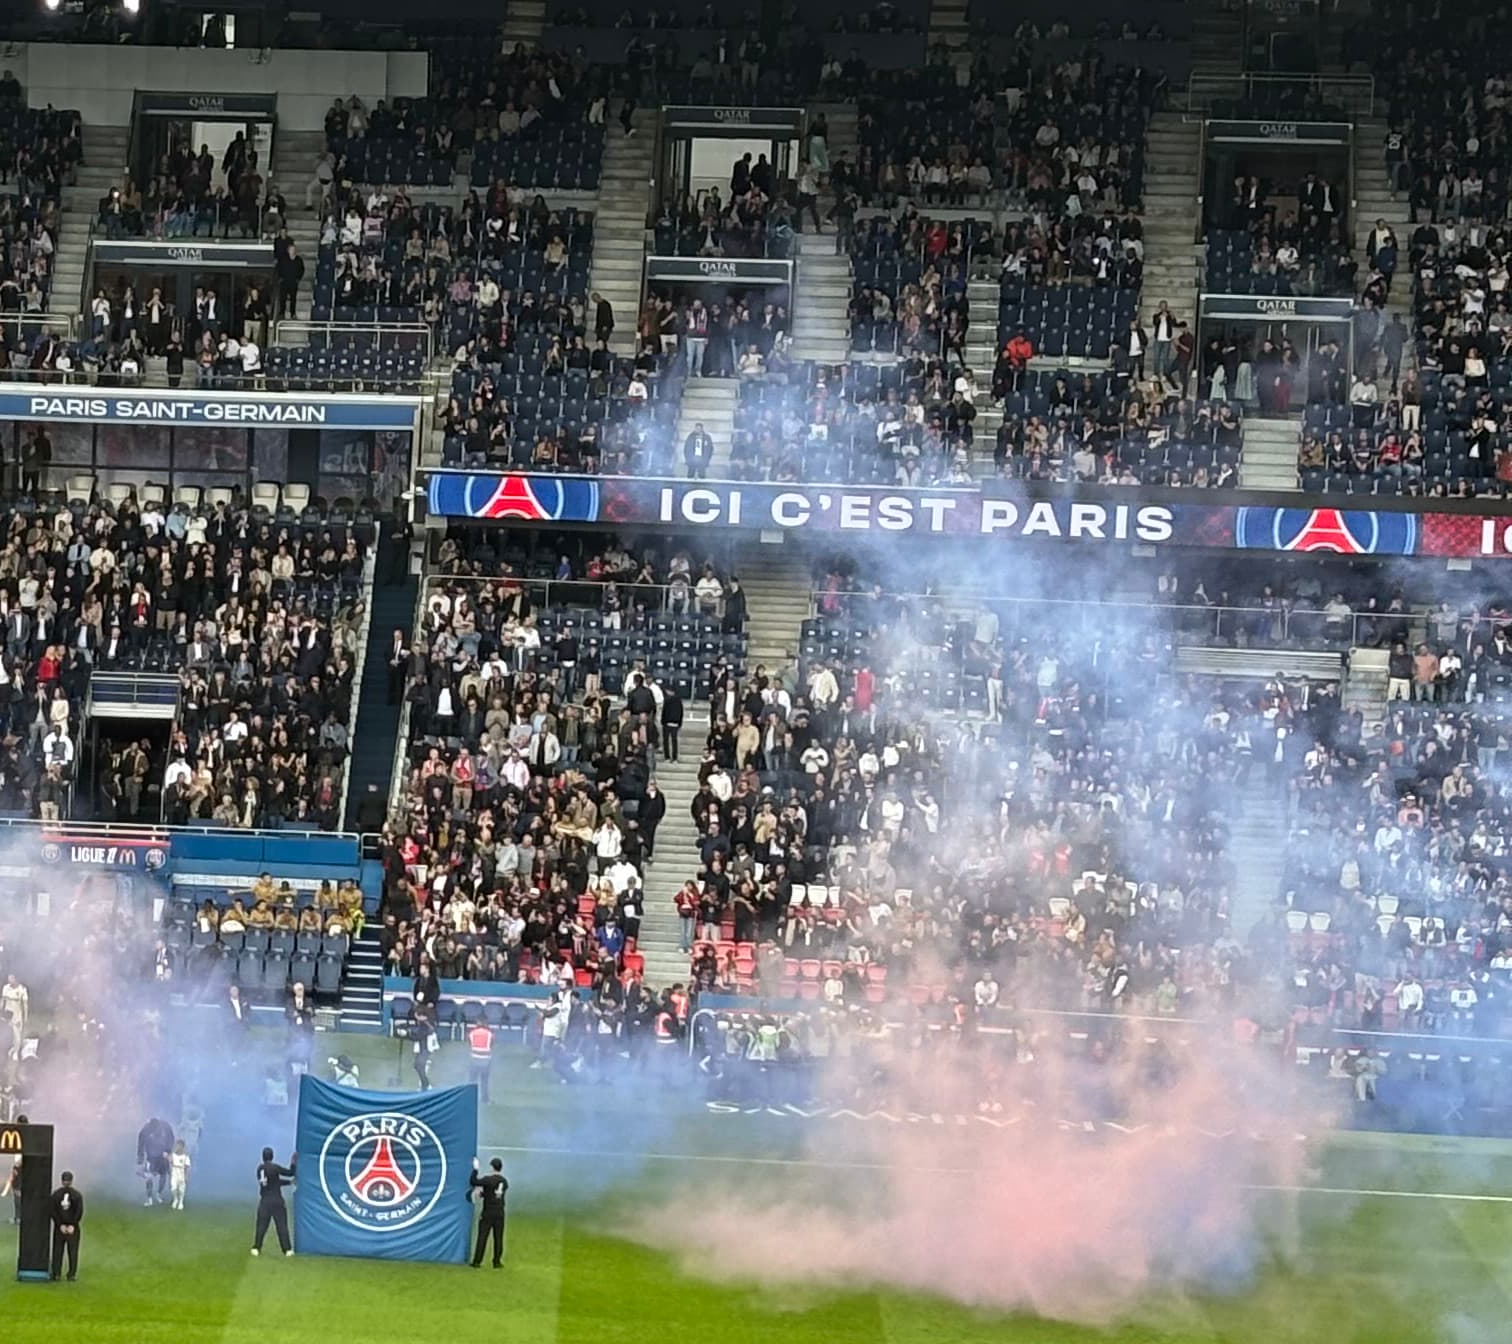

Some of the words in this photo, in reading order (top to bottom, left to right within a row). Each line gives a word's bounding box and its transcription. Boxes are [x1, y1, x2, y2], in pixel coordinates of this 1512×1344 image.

[189, 96, 224, 108] QATAR
[699, 262, 736, 273] QATAR
[1256, 300, 1295, 311] QATAR
[31, 397, 107, 417] PARIS
[115, 401, 326, 422] SAINT-GERMAIN
[660, 488, 741, 524] ICI
[771, 493, 955, 531] C'EST
[981, 500, 1173, 541] PARIS
[71, 846, 105, 864] LIGUE
[343, 1117, 426, 1147] PARIS
